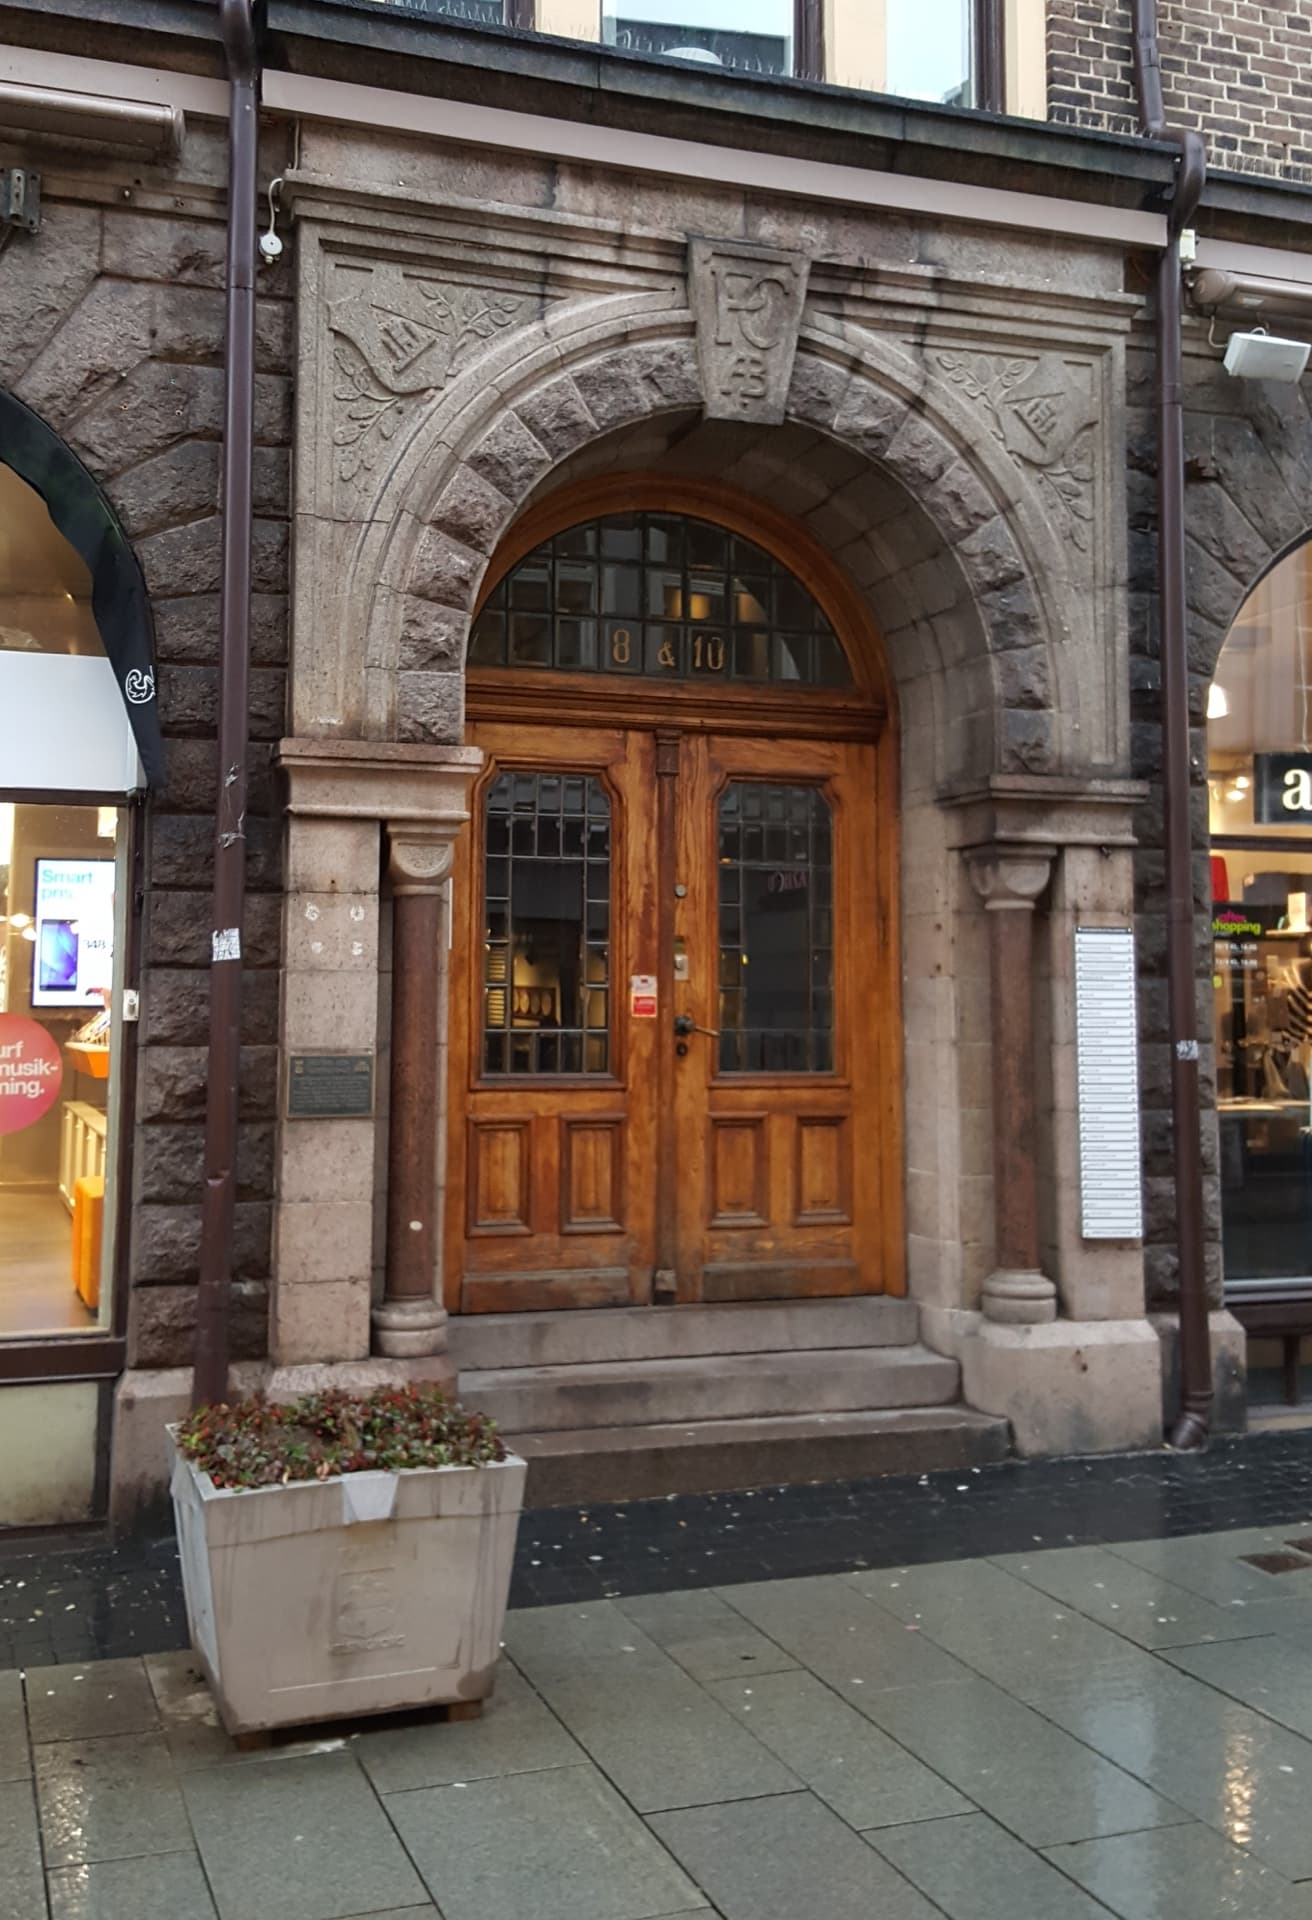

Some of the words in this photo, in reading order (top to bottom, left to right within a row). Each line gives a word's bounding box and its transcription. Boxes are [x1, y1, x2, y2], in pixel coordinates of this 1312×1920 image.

[613, 629, 630, 663] 8
[656, 640, 676, 667] &
[694, 635, 725, 670] 10
[42, 868, 93, 884] Smart
